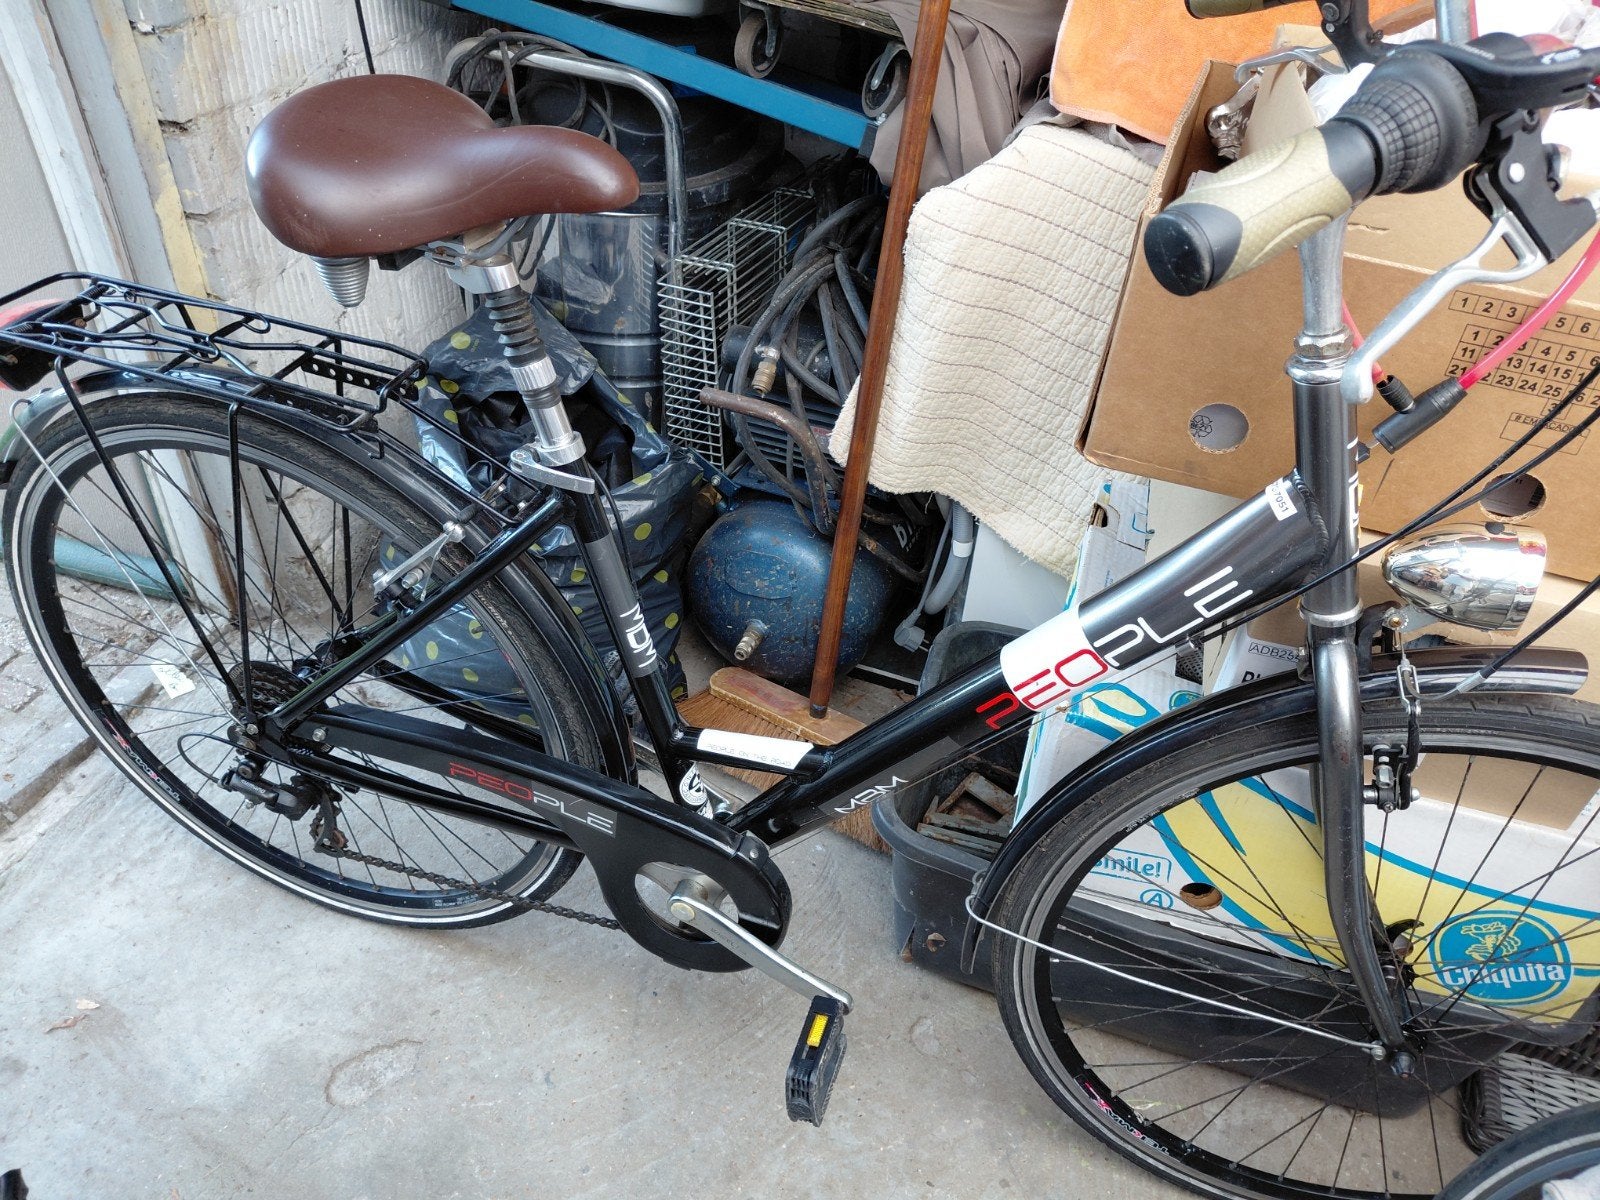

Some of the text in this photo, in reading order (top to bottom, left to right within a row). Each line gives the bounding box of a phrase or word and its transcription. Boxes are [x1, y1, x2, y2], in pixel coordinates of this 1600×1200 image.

[1461, 297, 1592, 333] 1 2 3 5 6
[1461, 346, 1476, 359] 11
[1506, 356, 1523, 369] 13
[1529, 362, 1547, 375] 14
[1553, 366, 1573, 380] 15
[1472, 330, 1480, 341] 1
[1492, 335, 1504, 346] 2
[1541, 345, 1552, 357] 4
[1565, 350, 1577, 362] 5
[1590, 355, 1600, 367] 6
[1495, 374, 1514, 387] 23
[1518, 379, 1538, 392] 24
[1542, 384, 1563, 398] 25
[449, 761, 614, 835] PEOPLE
[833, 775, 909, 814] MBM
[1441, 961, 1566, 989] Chiquita
